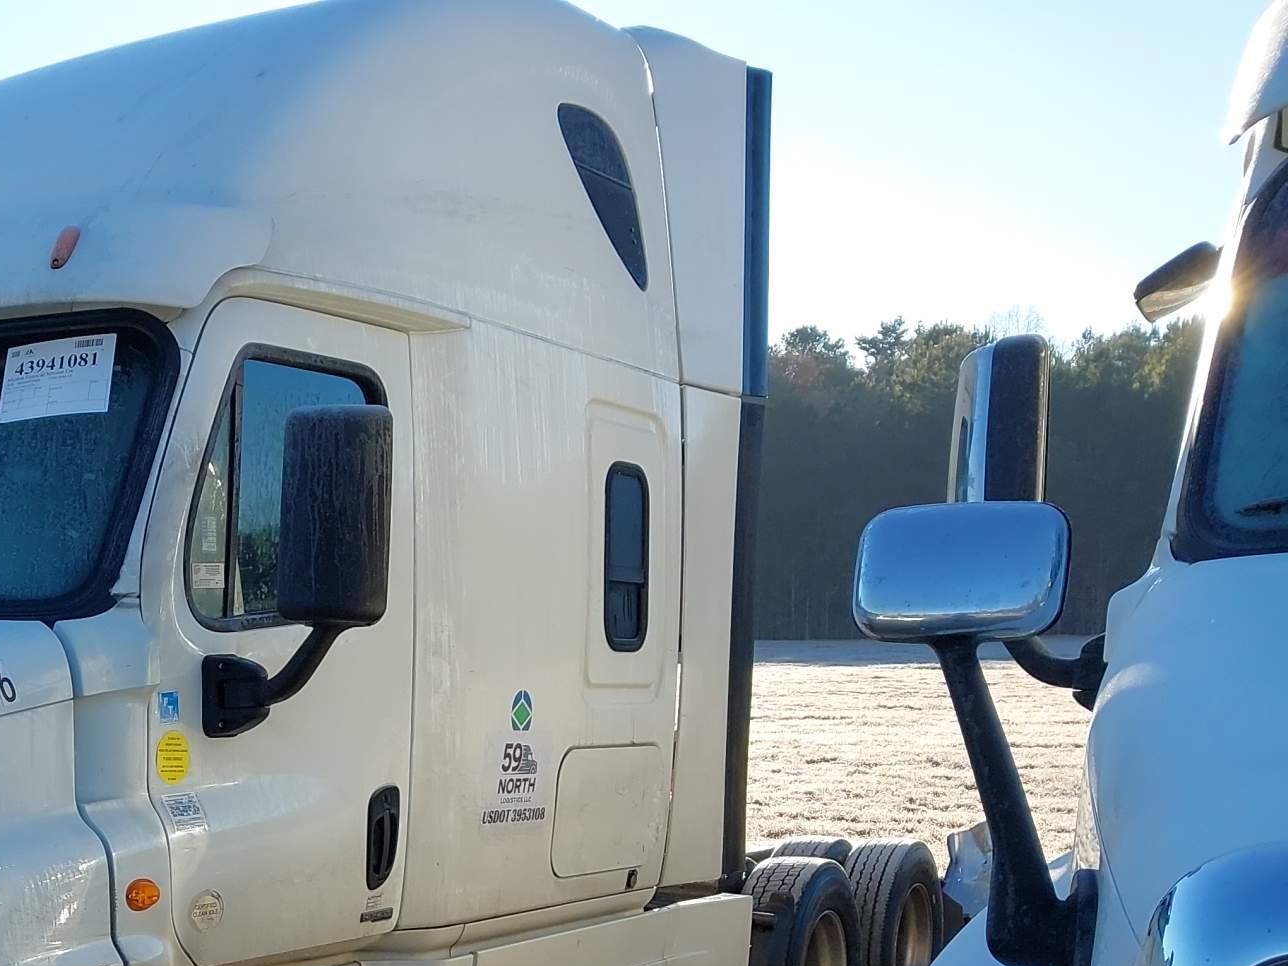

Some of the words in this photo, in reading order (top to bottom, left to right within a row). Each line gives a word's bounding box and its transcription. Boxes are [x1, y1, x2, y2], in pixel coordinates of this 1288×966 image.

[14, 351, 99, 376] 43941081
[501, 742, 523, 773] 59
[497, 777, 536, 795] NORTH
[482, 809, 511, 824] USDOT
[511, 807, 546, 823] 3953108
